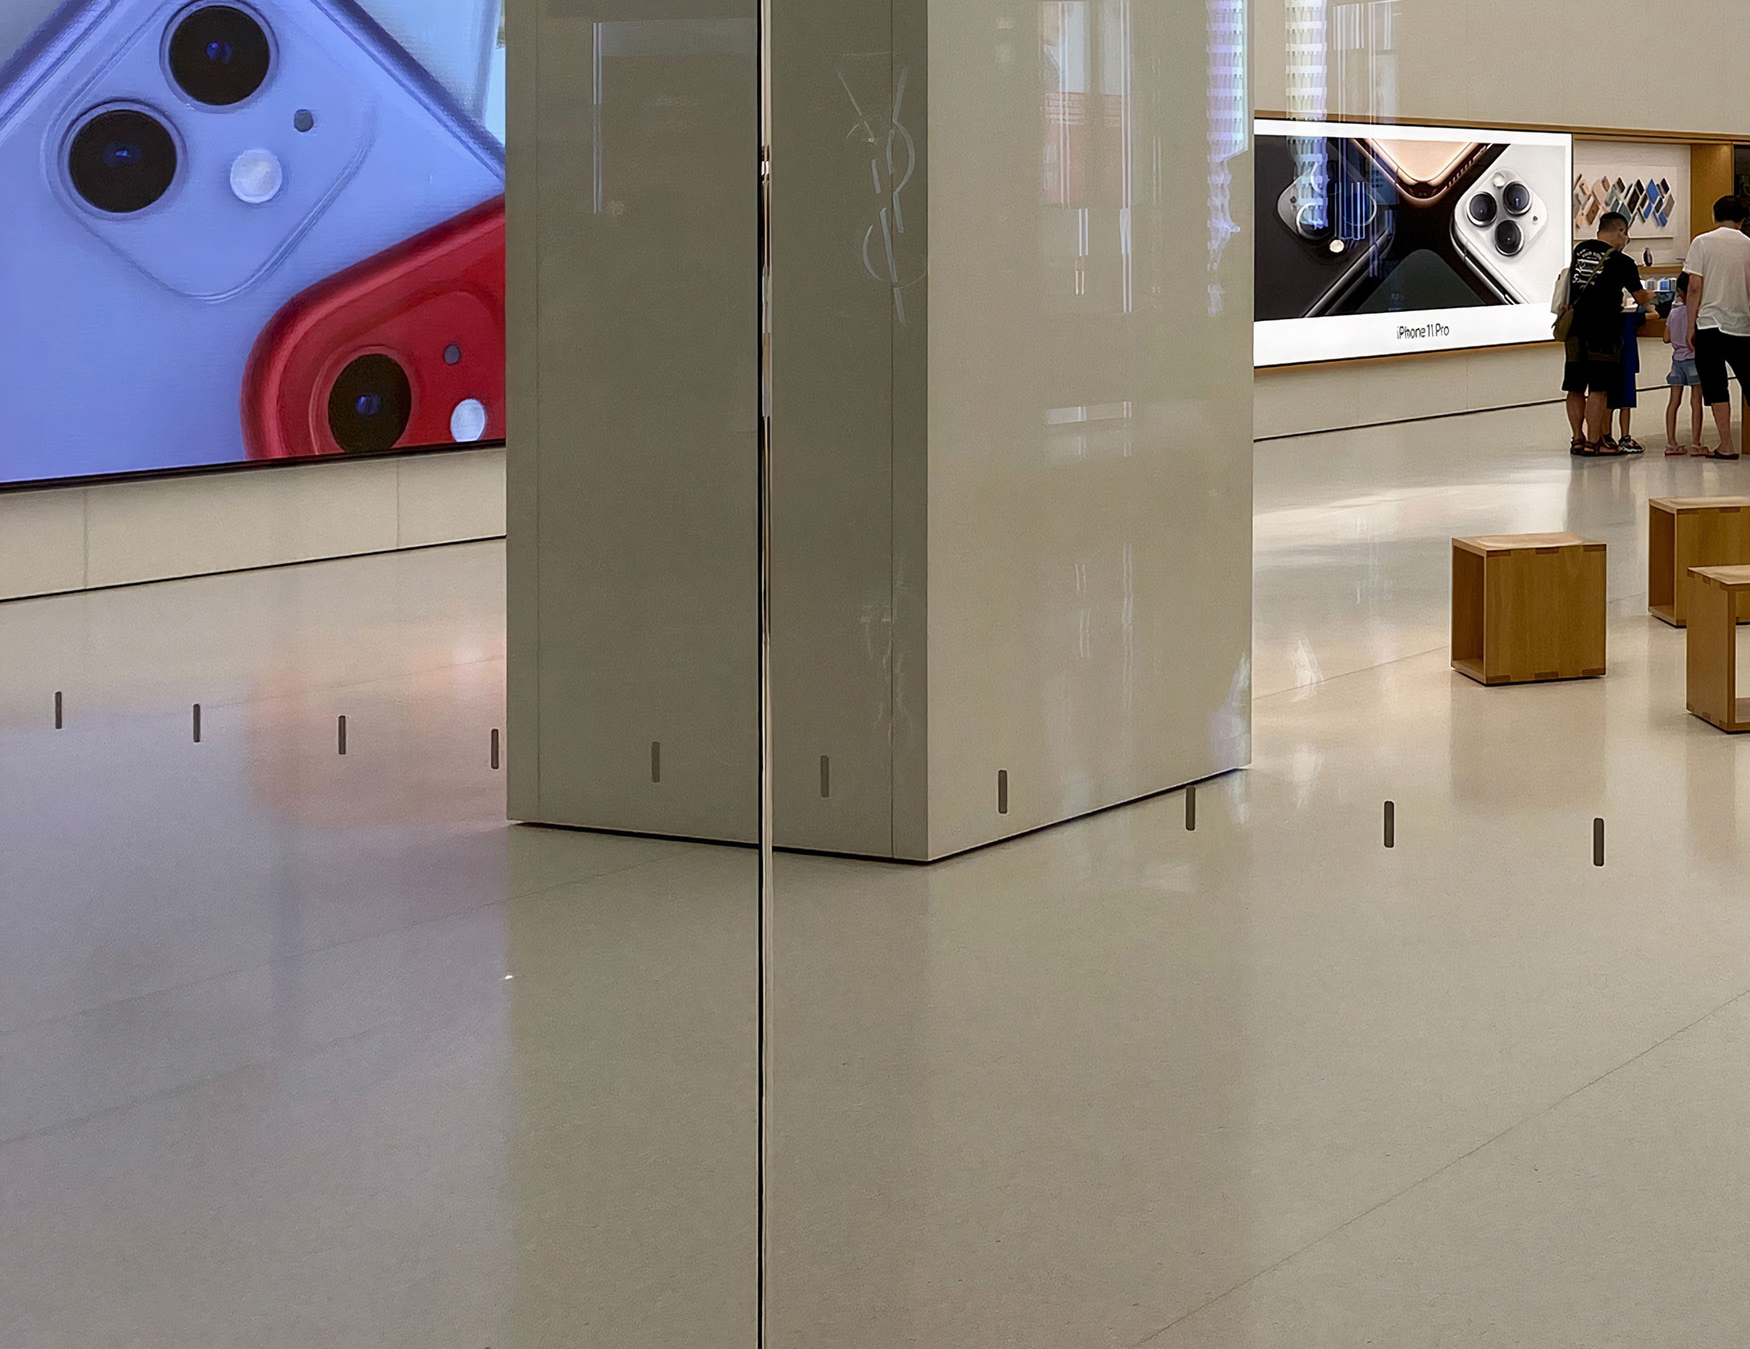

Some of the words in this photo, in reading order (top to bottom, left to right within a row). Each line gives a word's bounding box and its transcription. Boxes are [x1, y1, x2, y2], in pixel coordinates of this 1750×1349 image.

[1396, 326, 1426, 339] iPhone
[1427, 324, 1434, 337] 11
[1435, 323, 1450, 336] Pro
